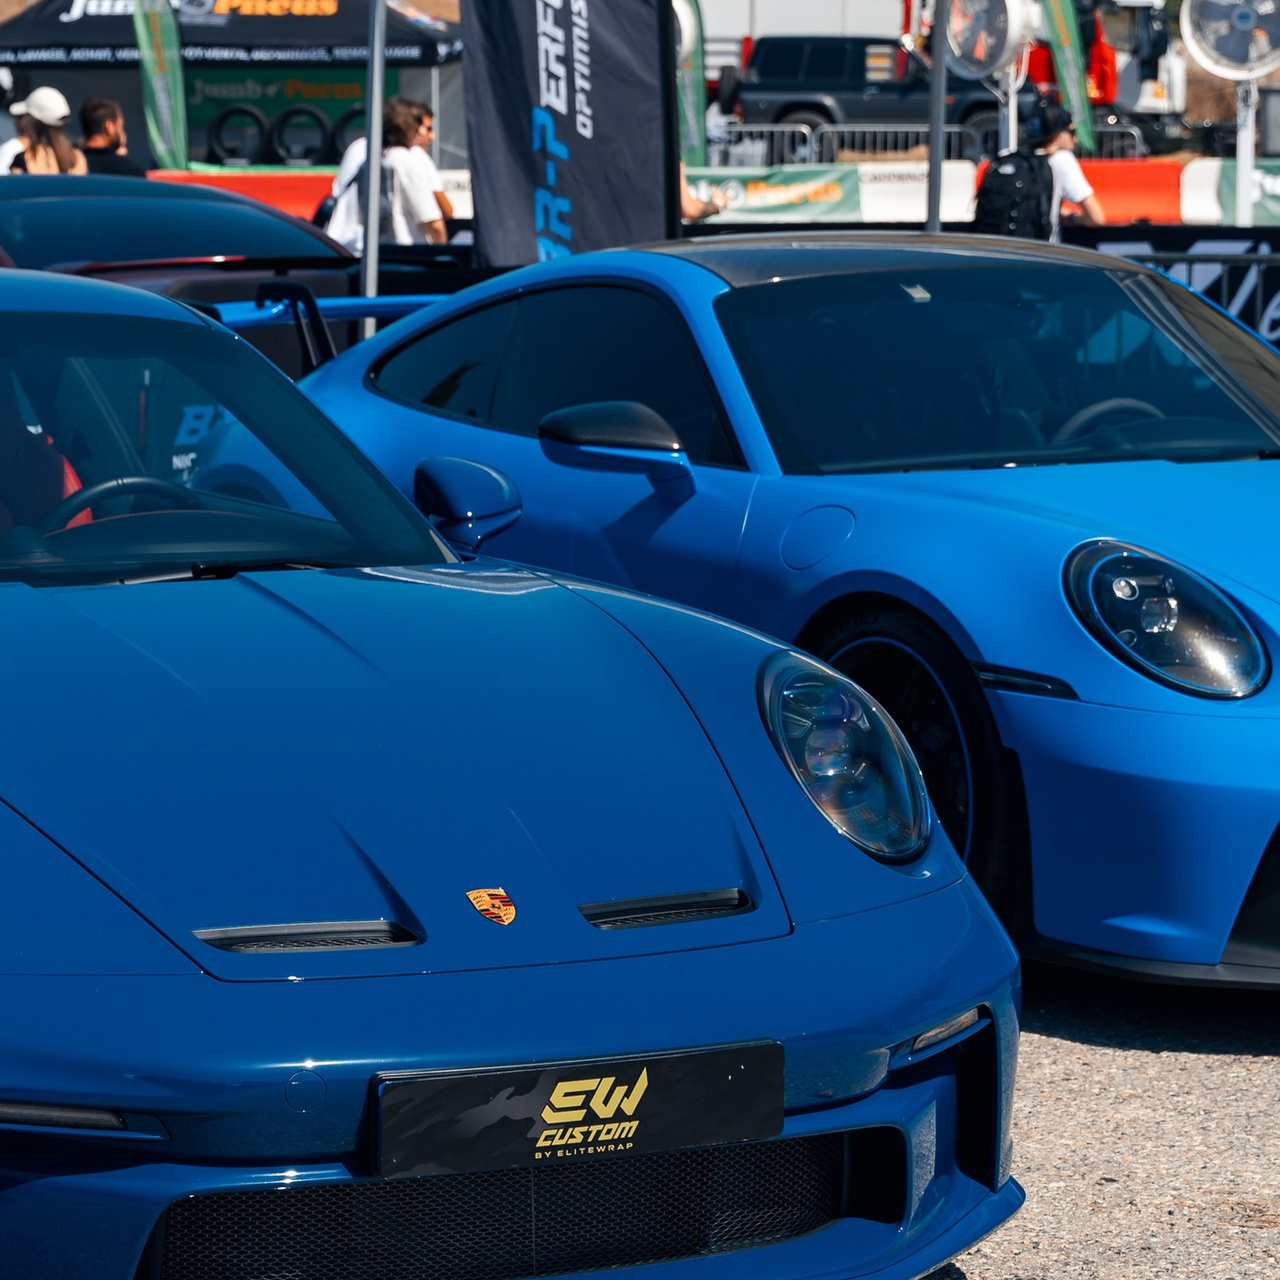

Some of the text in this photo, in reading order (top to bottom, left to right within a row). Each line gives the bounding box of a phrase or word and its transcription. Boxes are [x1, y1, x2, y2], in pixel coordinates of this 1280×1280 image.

[541, 1066, 649, 1124] EW
[535, 1120, 639, 1148] CUSTOM
[535, 1142, 635, 1160] BY ELITEWRAP
